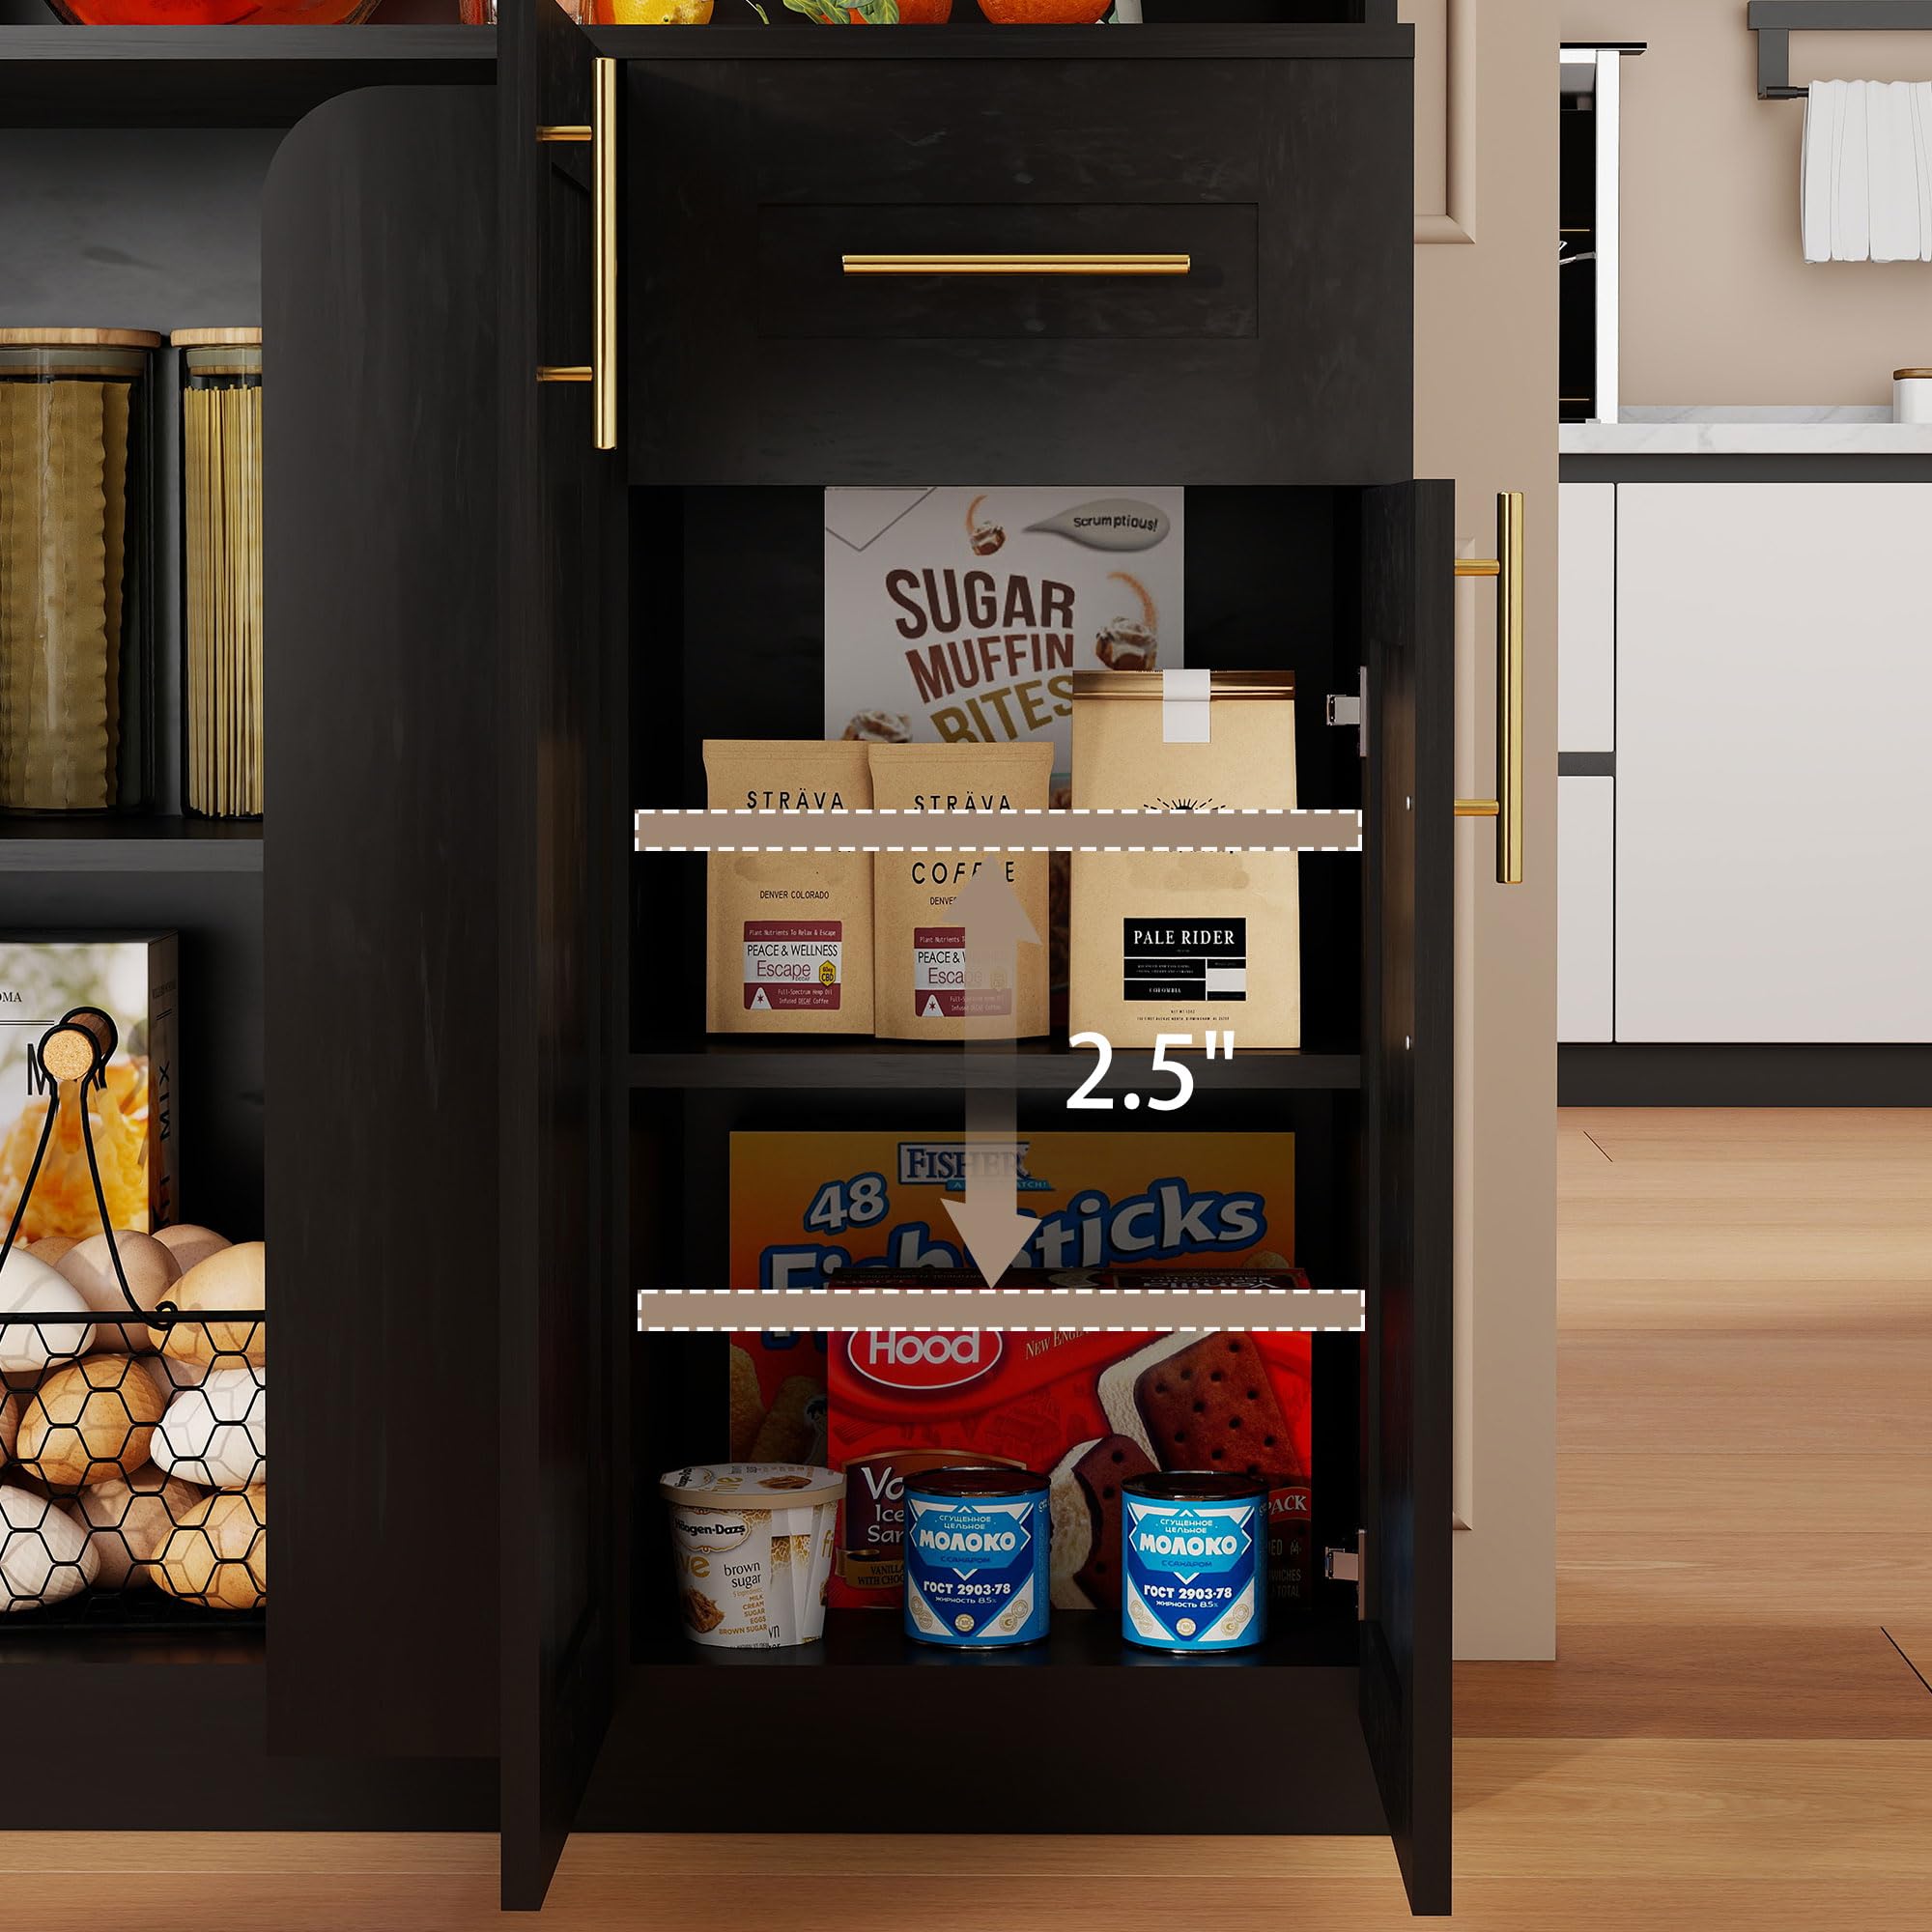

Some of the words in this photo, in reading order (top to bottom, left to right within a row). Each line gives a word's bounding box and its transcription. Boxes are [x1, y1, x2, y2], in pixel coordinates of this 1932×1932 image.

[885, 568, 1075, 639] SUGAR
[904, 633, 1074, 705] MUFFIN
[747, 788, 844, 810] STRÄVA
[912, 862, 1014, 884] COFE
[760, 891, 788, 899] DENVER
[791, 891, 829, 899] COLORADO
[1133, 930, 1175, 945] PALE
[1181, 930, 1235, 945] RIDER
[747, 945, 779, 956] PEACE
[781, 945, 788, 956] &
[791, 945, 838, 956] WELLNESS
[918, 951, 951, 963] PEACE
[952, 951, 960, 963] &
[756, 960, 810, 980] Escape
[821, 973, 834, 981] CBD
[808, 1178, 885, 1230] 48
[869, 1330, 980, 1364] Hood
[875, 1504, 904, 1522] Ice
[919, 1529, 1016, 1552] МОЛОКО
[1139, 1533, 1237, 1556] МОЛОКО
[724, 1562, 760, 1577] brown
[731, 1574, 762, 1590] sugar
[858, 1576, 880, 1585] WITH
[923, 1580, 953, 1594] ГОСТ
[1144, 1584, 1175, 1599] ГОСТ
[742, 1602, 765, 1610] CREAM
[744, 1608, 765, 1617] SUGAR
[719, 1626, 745, 1635] BROWN
[746, 1624, 768, 1633] SUGAR
